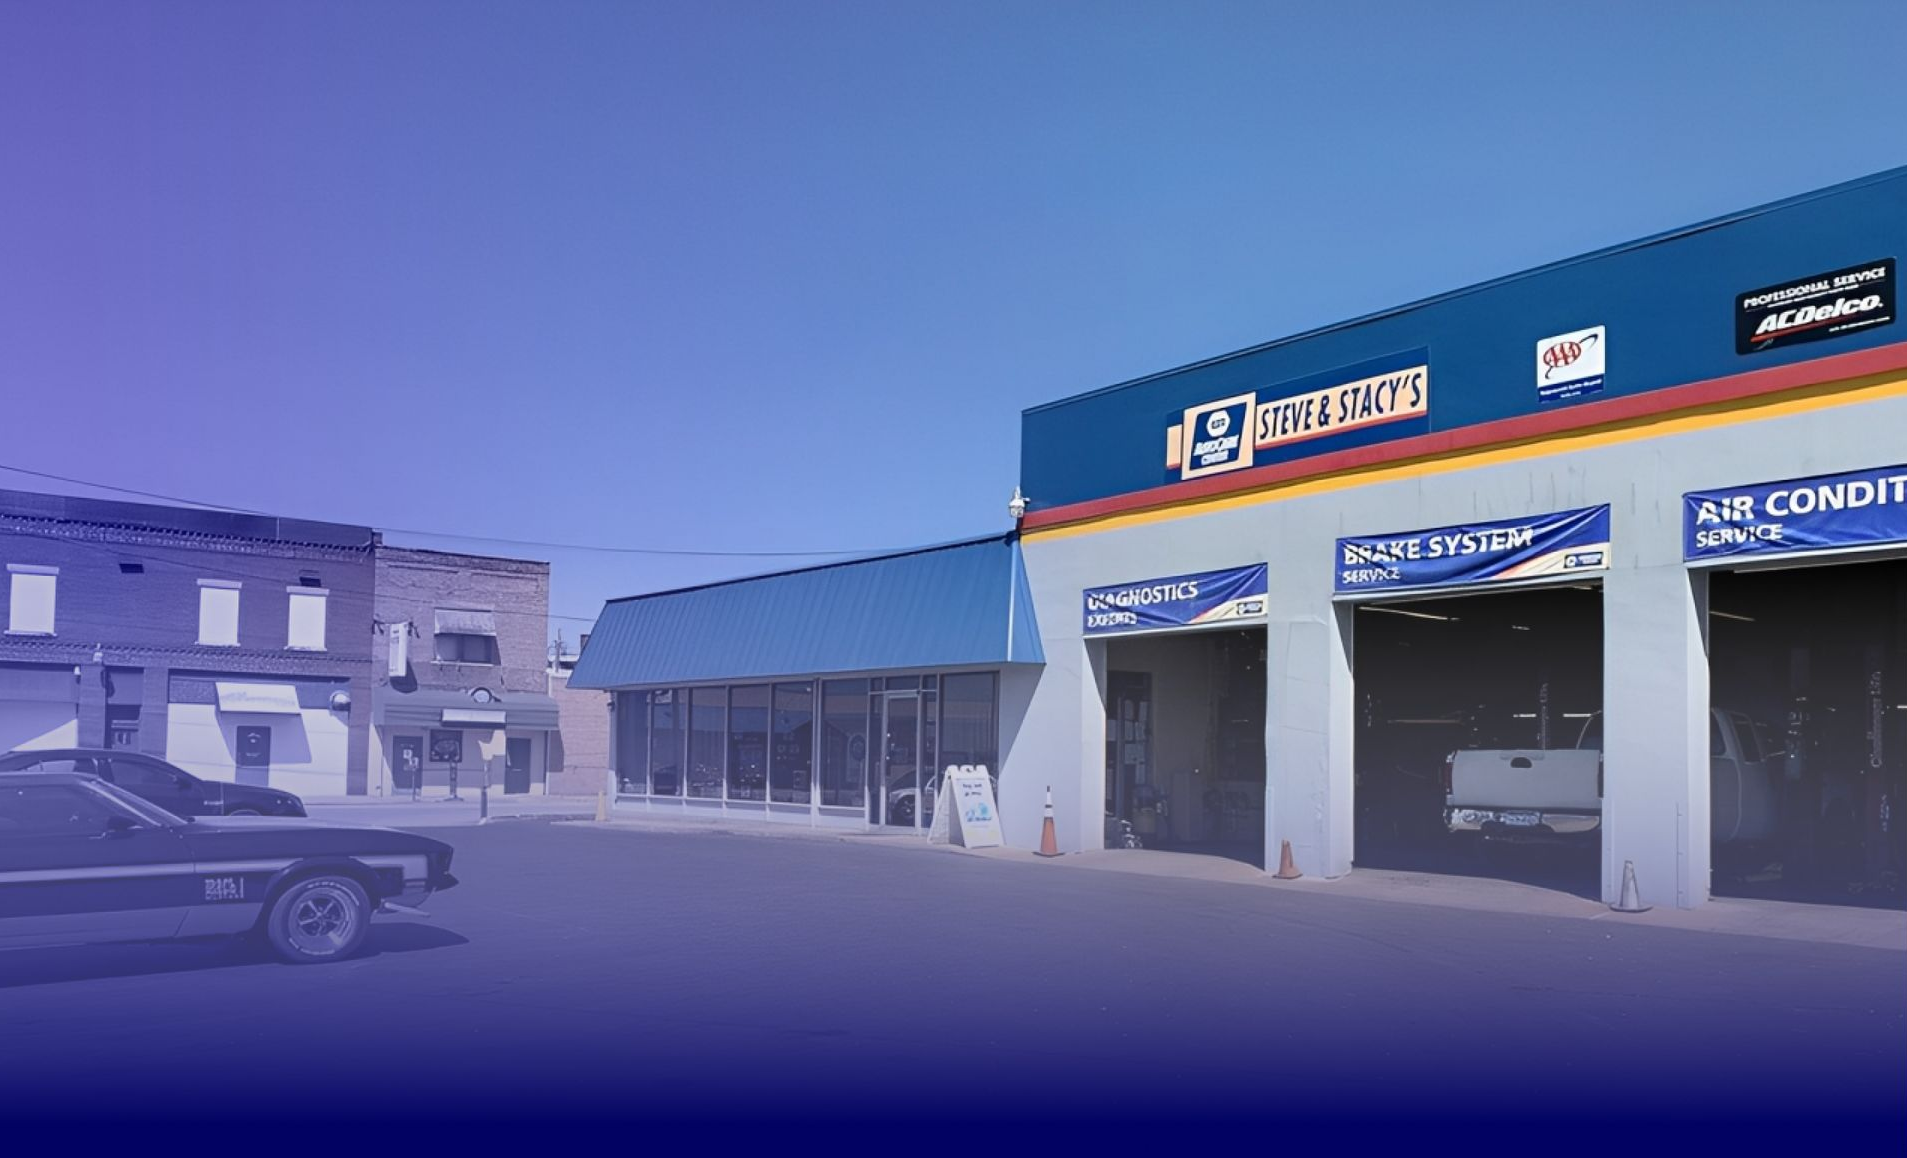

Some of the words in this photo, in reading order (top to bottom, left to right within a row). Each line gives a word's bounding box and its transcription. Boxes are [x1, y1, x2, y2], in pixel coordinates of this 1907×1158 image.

[1744, 280, 1830, 309] PROFESSIONAL
[1833, 267, 1886, 287] SERVICE
[1260, 399, 1314, 440] STEVE
[1318, 395, 1331, 427] &
[1339, 372, 1422, 423] STACY'S
[1696, 496, 1754, 525] AIR
[1765, 475, 1907, 517] CONDIT
[1344, 539, 1420, 565] BRAKE
[1429, 527, 1533, 559] SYSTEM
[1696, 523, 1783, 547] SERVICE
[1343, 567, 1400, 584] SERVICE
[1088, 581, 1198, 610] DIAGNOSTICS
